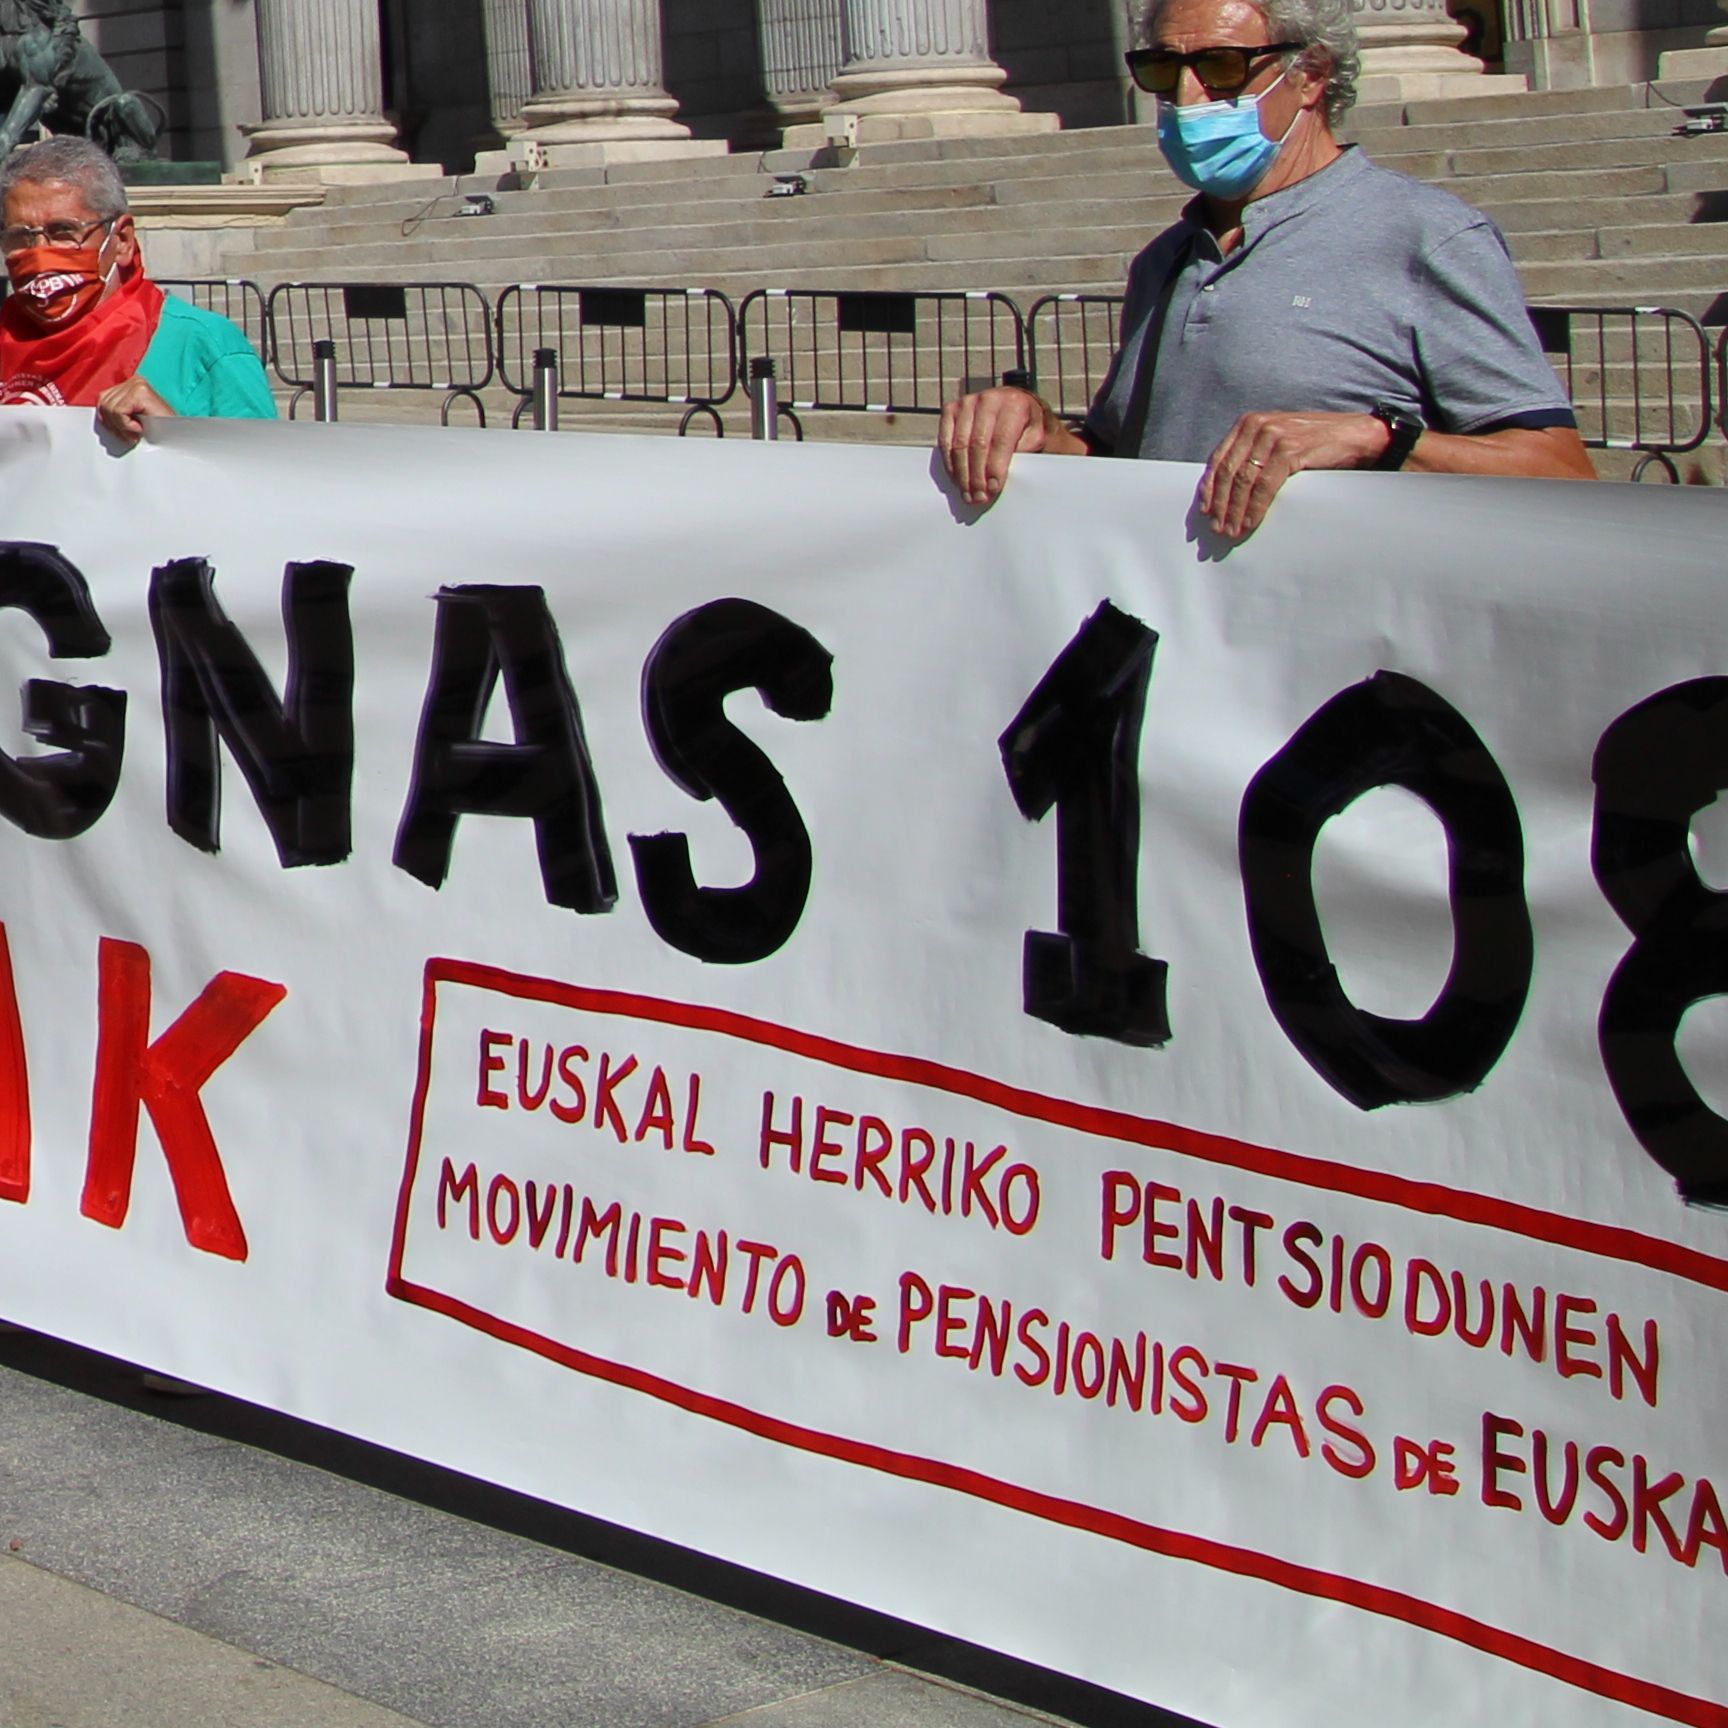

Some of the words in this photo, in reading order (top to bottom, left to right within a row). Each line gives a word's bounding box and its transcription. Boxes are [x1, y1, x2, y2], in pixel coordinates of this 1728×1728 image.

[436, 1157, 805, 1327] MOVIMIENTO
[826, 1290, 879, 1343] DE
[897, 1269, 1376, 1478] PENSIONISTAS
[1393, 1435, 1459, 1496] DE
[476, 1028, 715, 1157] EUSKAL
[758, 1090, 1041, 1237] HERRIKO
[1100, 1169, 1660, 1408] PENTSIODUNEN
